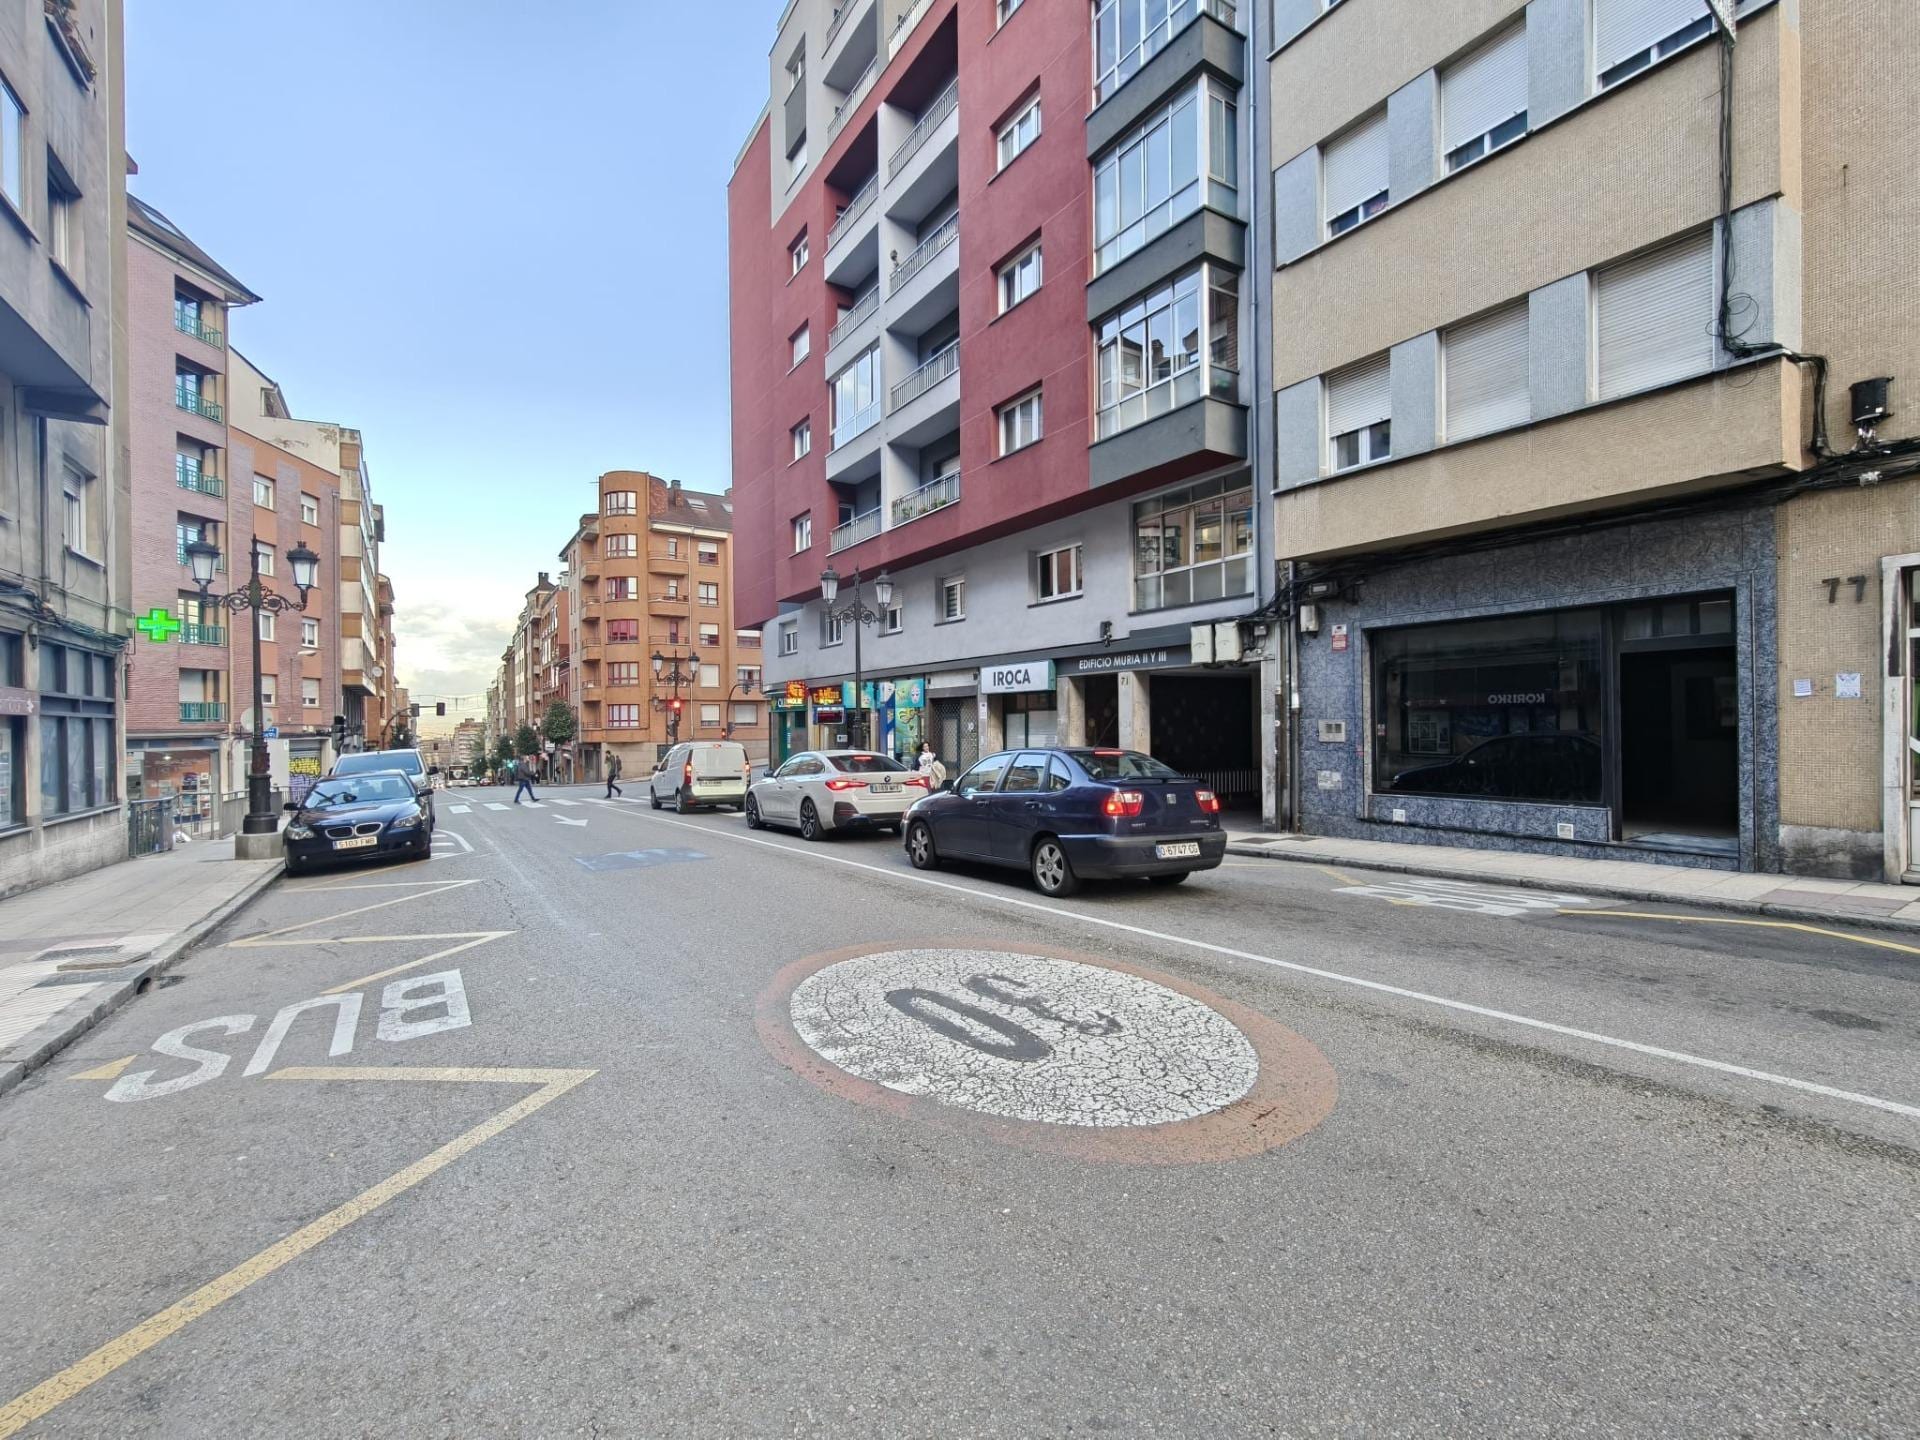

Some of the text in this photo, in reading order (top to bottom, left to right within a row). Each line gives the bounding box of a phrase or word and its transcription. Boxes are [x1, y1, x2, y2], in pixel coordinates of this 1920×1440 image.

[1822, 575, 1866, 603] 77
[1079, 657, 1112, 670] EDIFICIO
[1113, 654, 1141, 667] MURIA
[1150, 652, 1156, 663] Y
[1158, 651, 1167, 662] III
[993, 668, 1031, 687] IROCA
[104, 968, 472, 1103] BUS
